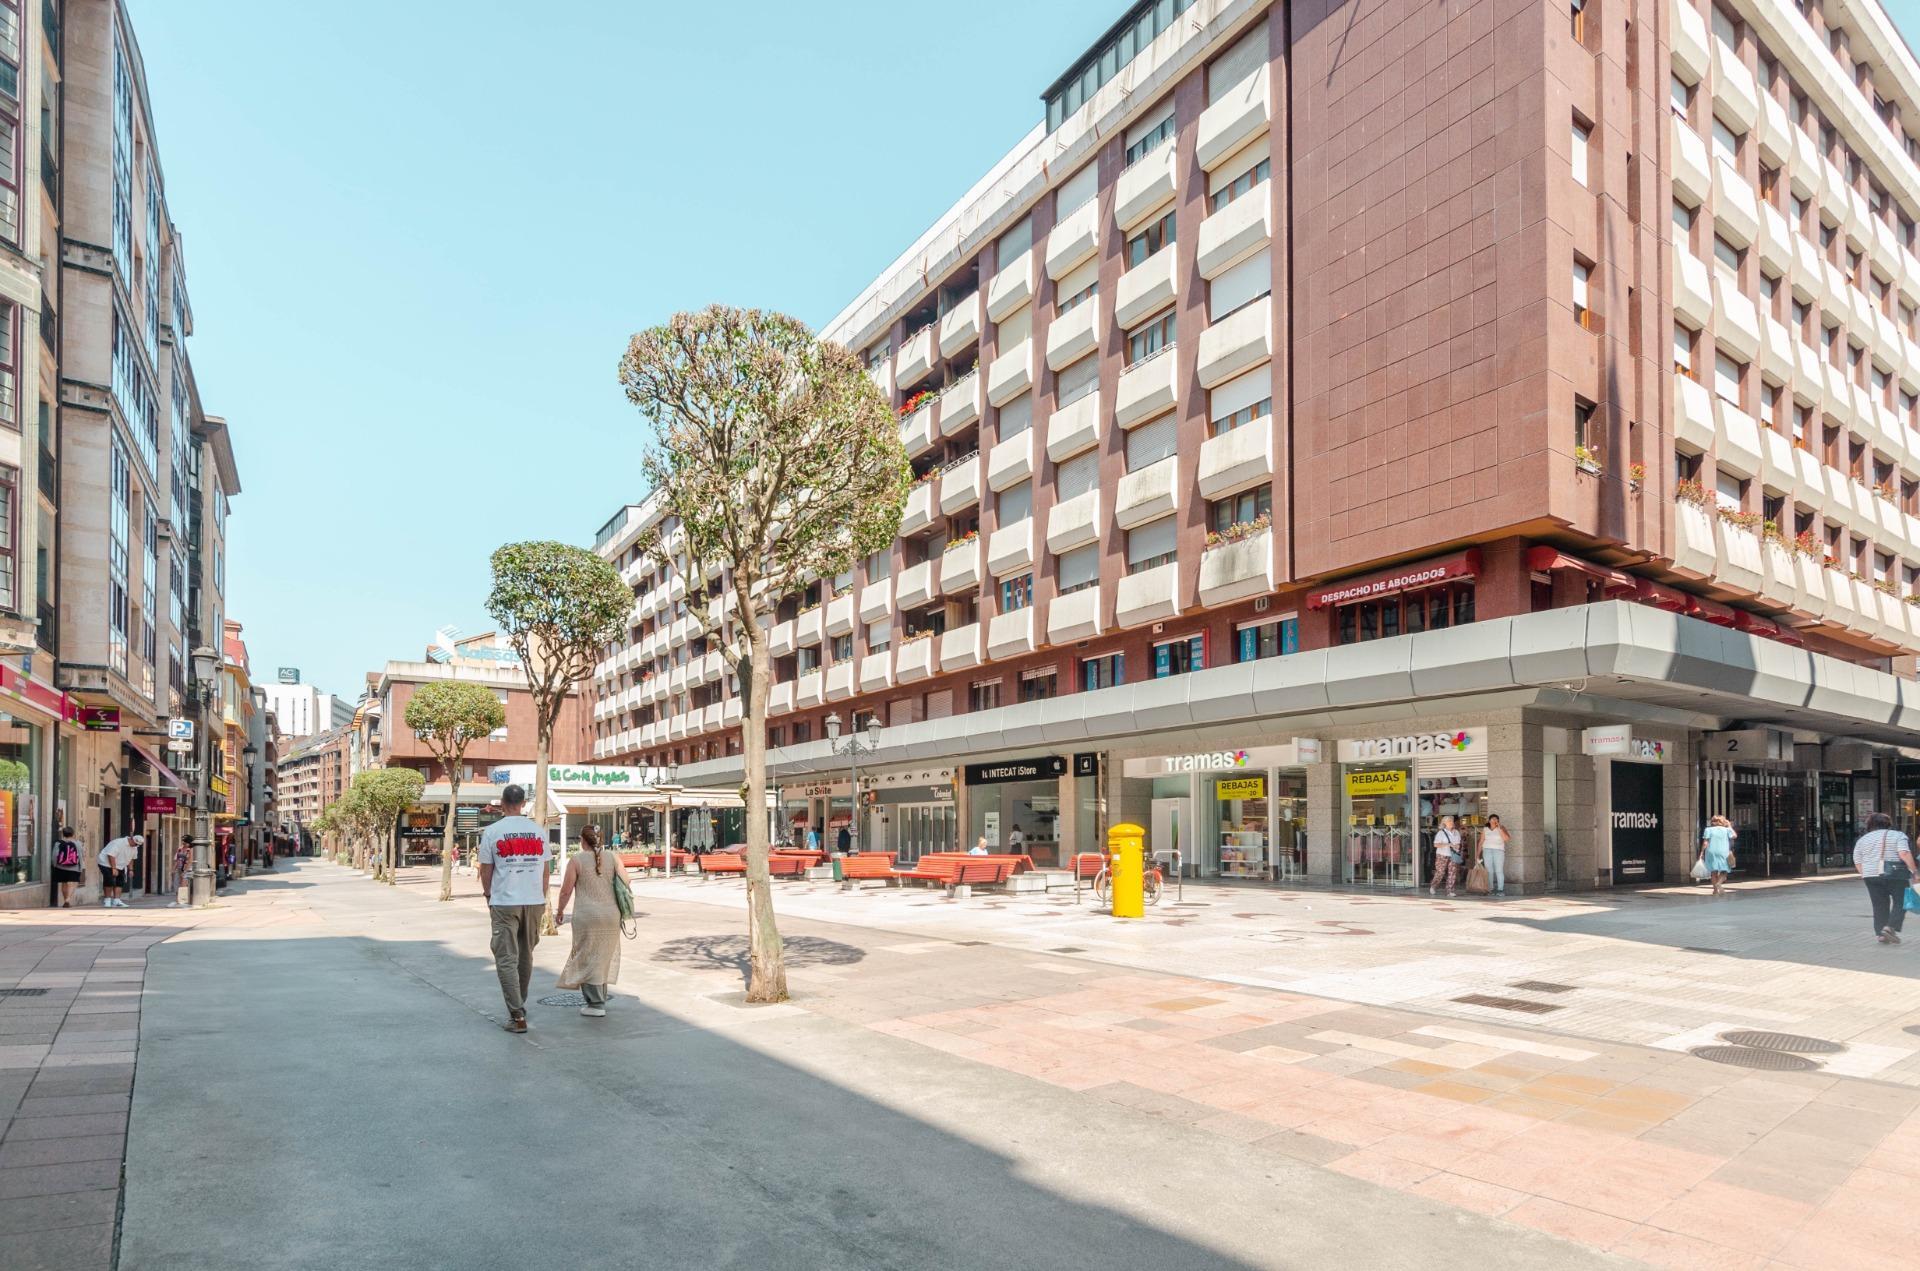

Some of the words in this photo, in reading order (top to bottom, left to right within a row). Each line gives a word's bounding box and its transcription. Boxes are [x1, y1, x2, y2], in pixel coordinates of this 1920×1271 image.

[1321, 585, 1371, 603] DESPACHO
[1372, 581, 1386, 593] DE
[1387, 567, 1446, 589] ABOGADOS
[1727, 739, 1738, 752] 2
[549, 767, 561, 782] El
[562, 768, 591, 783] Corte
[989, 767, 1016, 778] INTECAT
[1017, 766, 1037, 776] iStore
[1352, 773, 1400, 784] REBAJAS
[805, 786, 814, 796] La
[1221, 780, 1259, 790] REBAJAS
